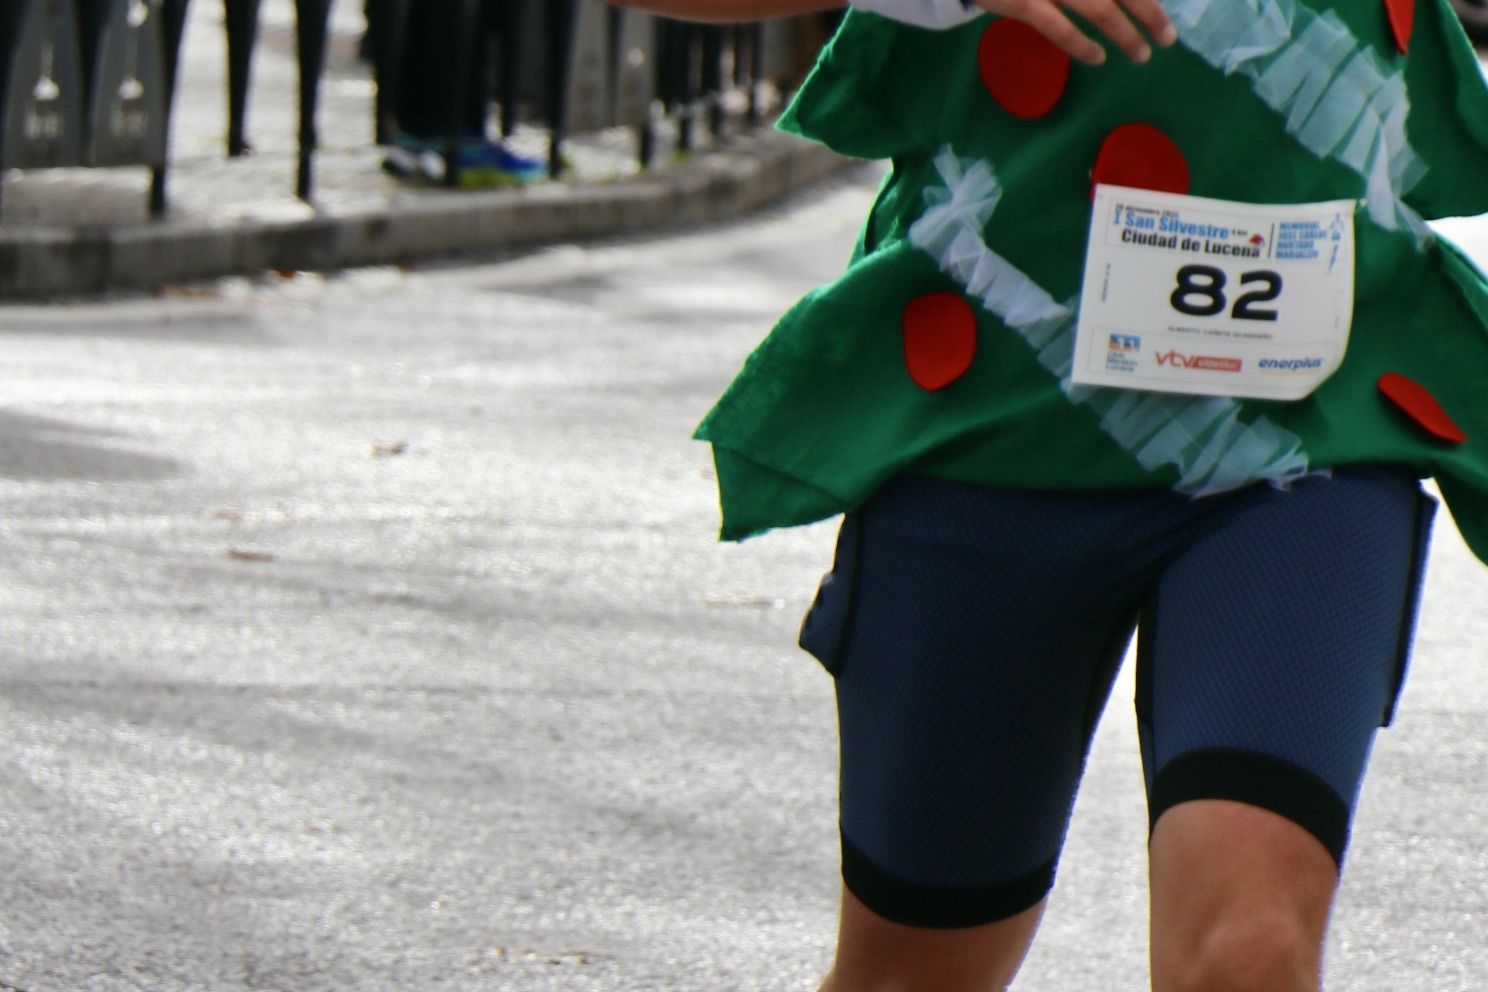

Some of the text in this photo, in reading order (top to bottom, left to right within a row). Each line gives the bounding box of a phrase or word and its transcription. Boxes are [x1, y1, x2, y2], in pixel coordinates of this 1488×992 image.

[1125, 210, 1155, 229] San
[1159, 216, 1230, 240] Silvestre
[1122, 228, 1178, 249] Ciudad
[1181, 237, 1200, 251] de
[1204, 239, 1260, 258] Lucena
[1169, 263, 1284, 322] 82
[1155, 348, 1195, 369] vtv
[1258, 357, 1323, 372] enerplus
